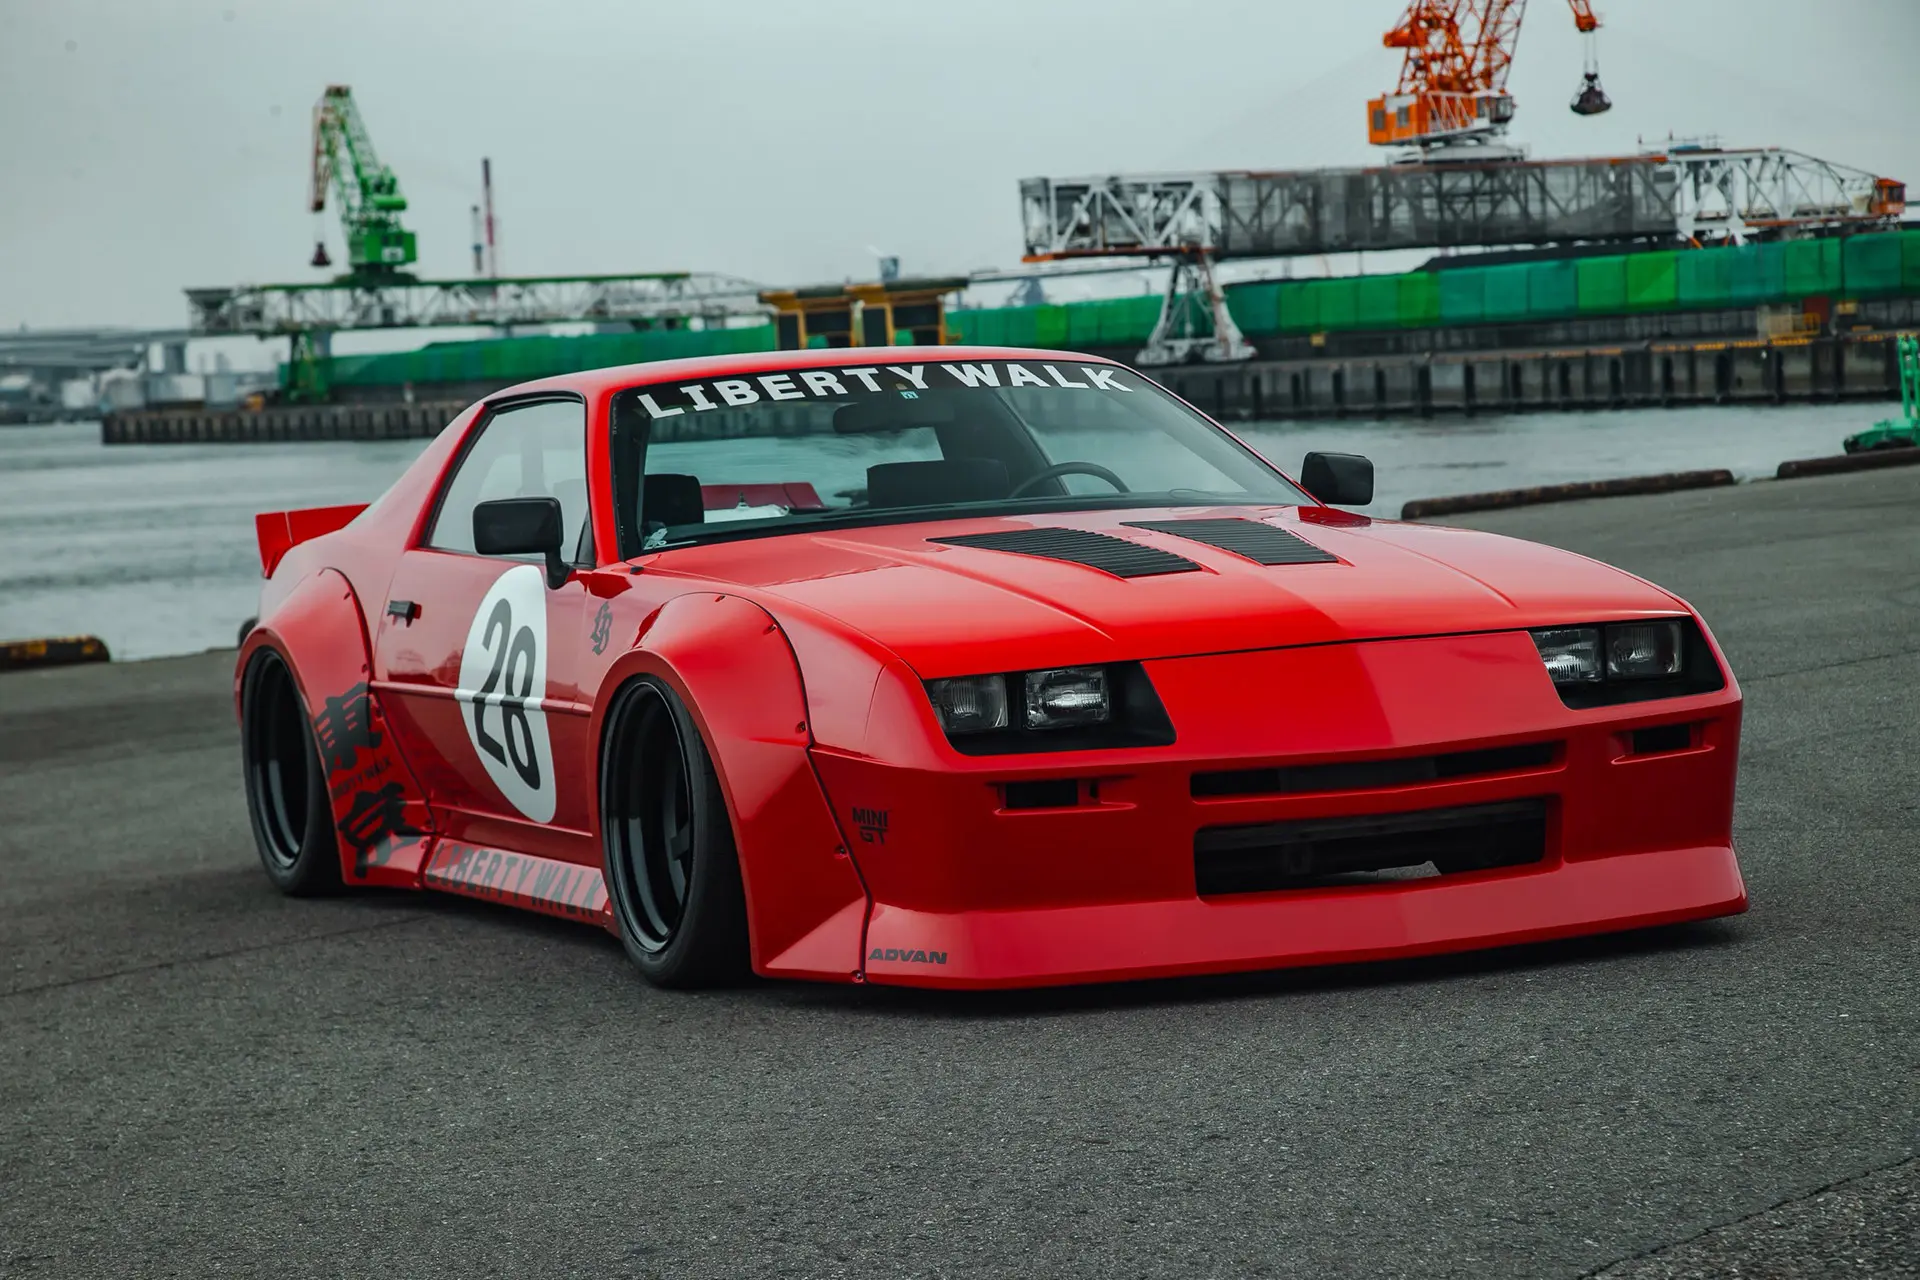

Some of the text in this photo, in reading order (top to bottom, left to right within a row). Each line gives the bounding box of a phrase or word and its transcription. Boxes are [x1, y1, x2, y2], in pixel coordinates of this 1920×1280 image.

[637, 363, 1134, 419] LIBERTY WALK
[473, 598, 541, 790] 28
[852, 806, 888, 827] MINI
[859, 826, 888, 844] GT
[425, 842, 604, 918] LIBERTY WALK
[868, 948, 948, 965] ADVAN
